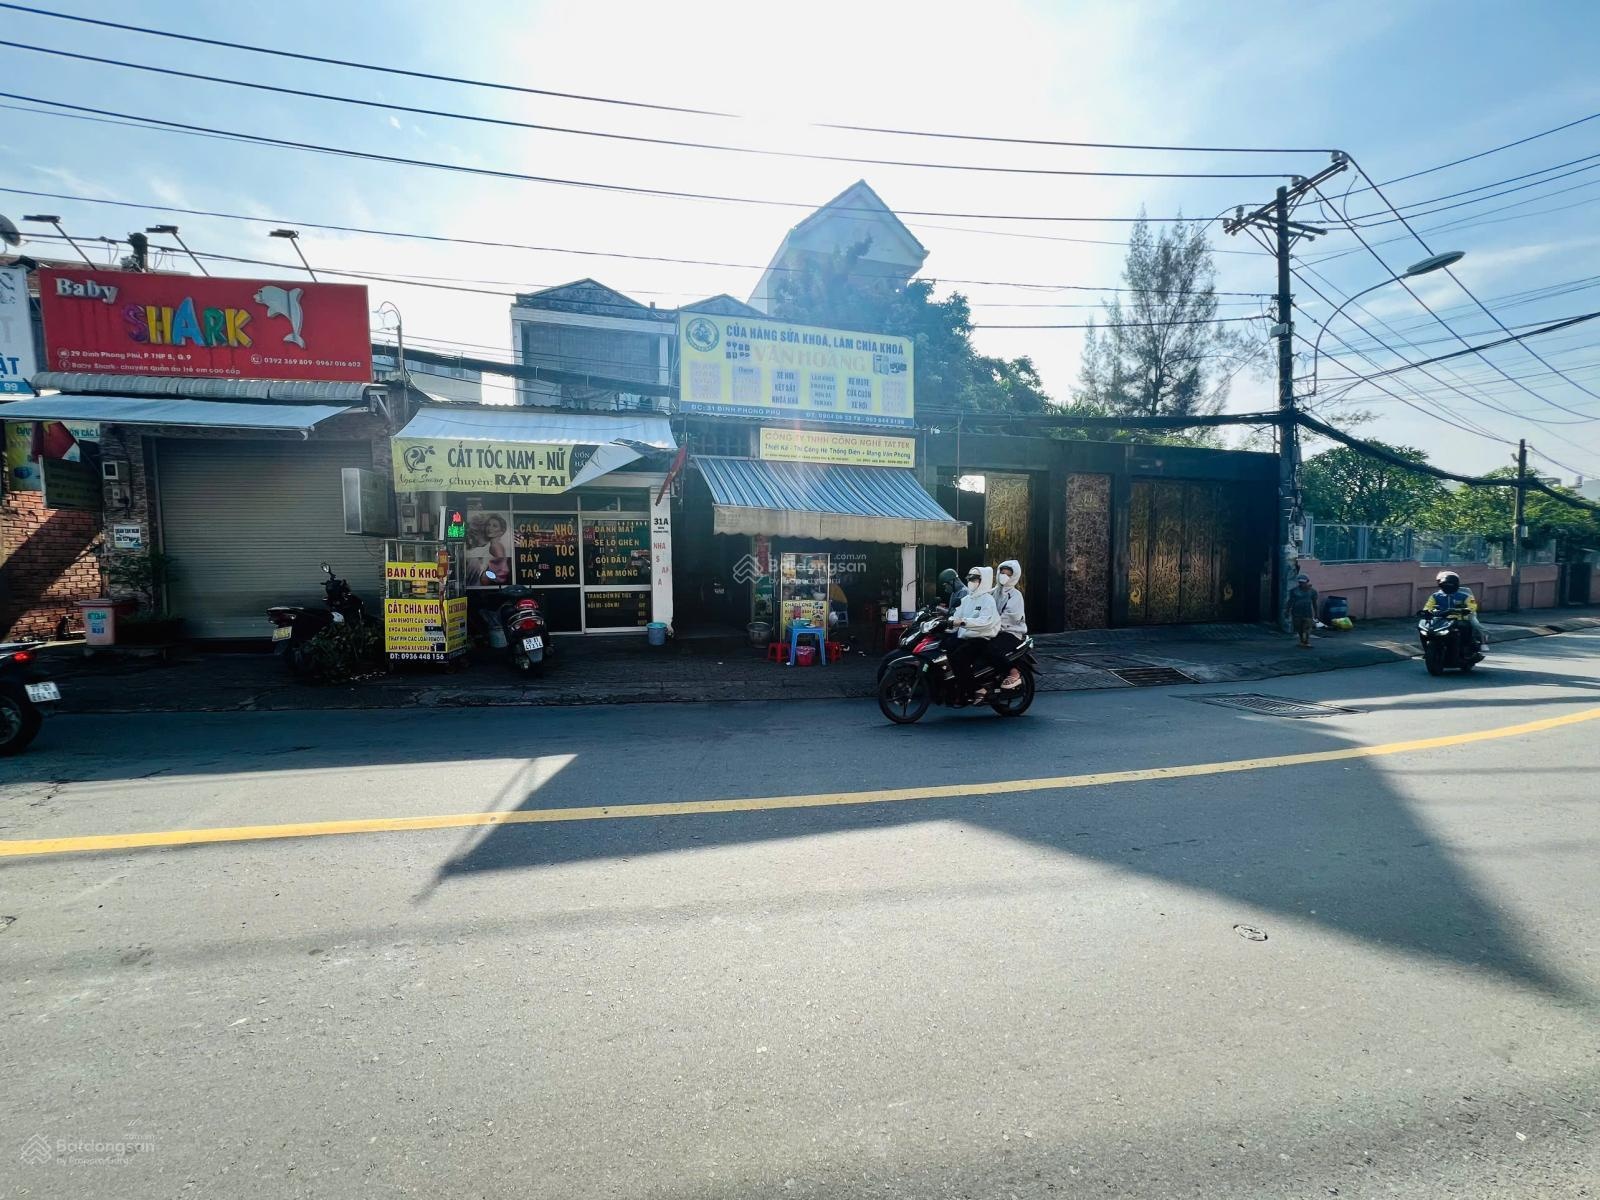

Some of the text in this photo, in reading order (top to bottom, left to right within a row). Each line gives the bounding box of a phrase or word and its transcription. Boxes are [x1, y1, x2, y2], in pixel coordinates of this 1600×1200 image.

[55, 278, 119, 305] Baby
[122, 297, 253, 348] SHARK
[101, 352, 125, 362] Phong
[765, 431, 792, 442] CÔNG
[448, 440, 472, 468] CẮT
[477, 445, 503, 470] TÓC
[506, 449, 535, 471] NAM
[495, 473, 533, 487] RÁY
[538, 476, 566, 488] TAI
[419, 568, 438, 579] KHO
[555, 565, 575, 580] BẠC
[388, 600, 402, 614] CẮT
[424, 604, 440, 615] KHO
